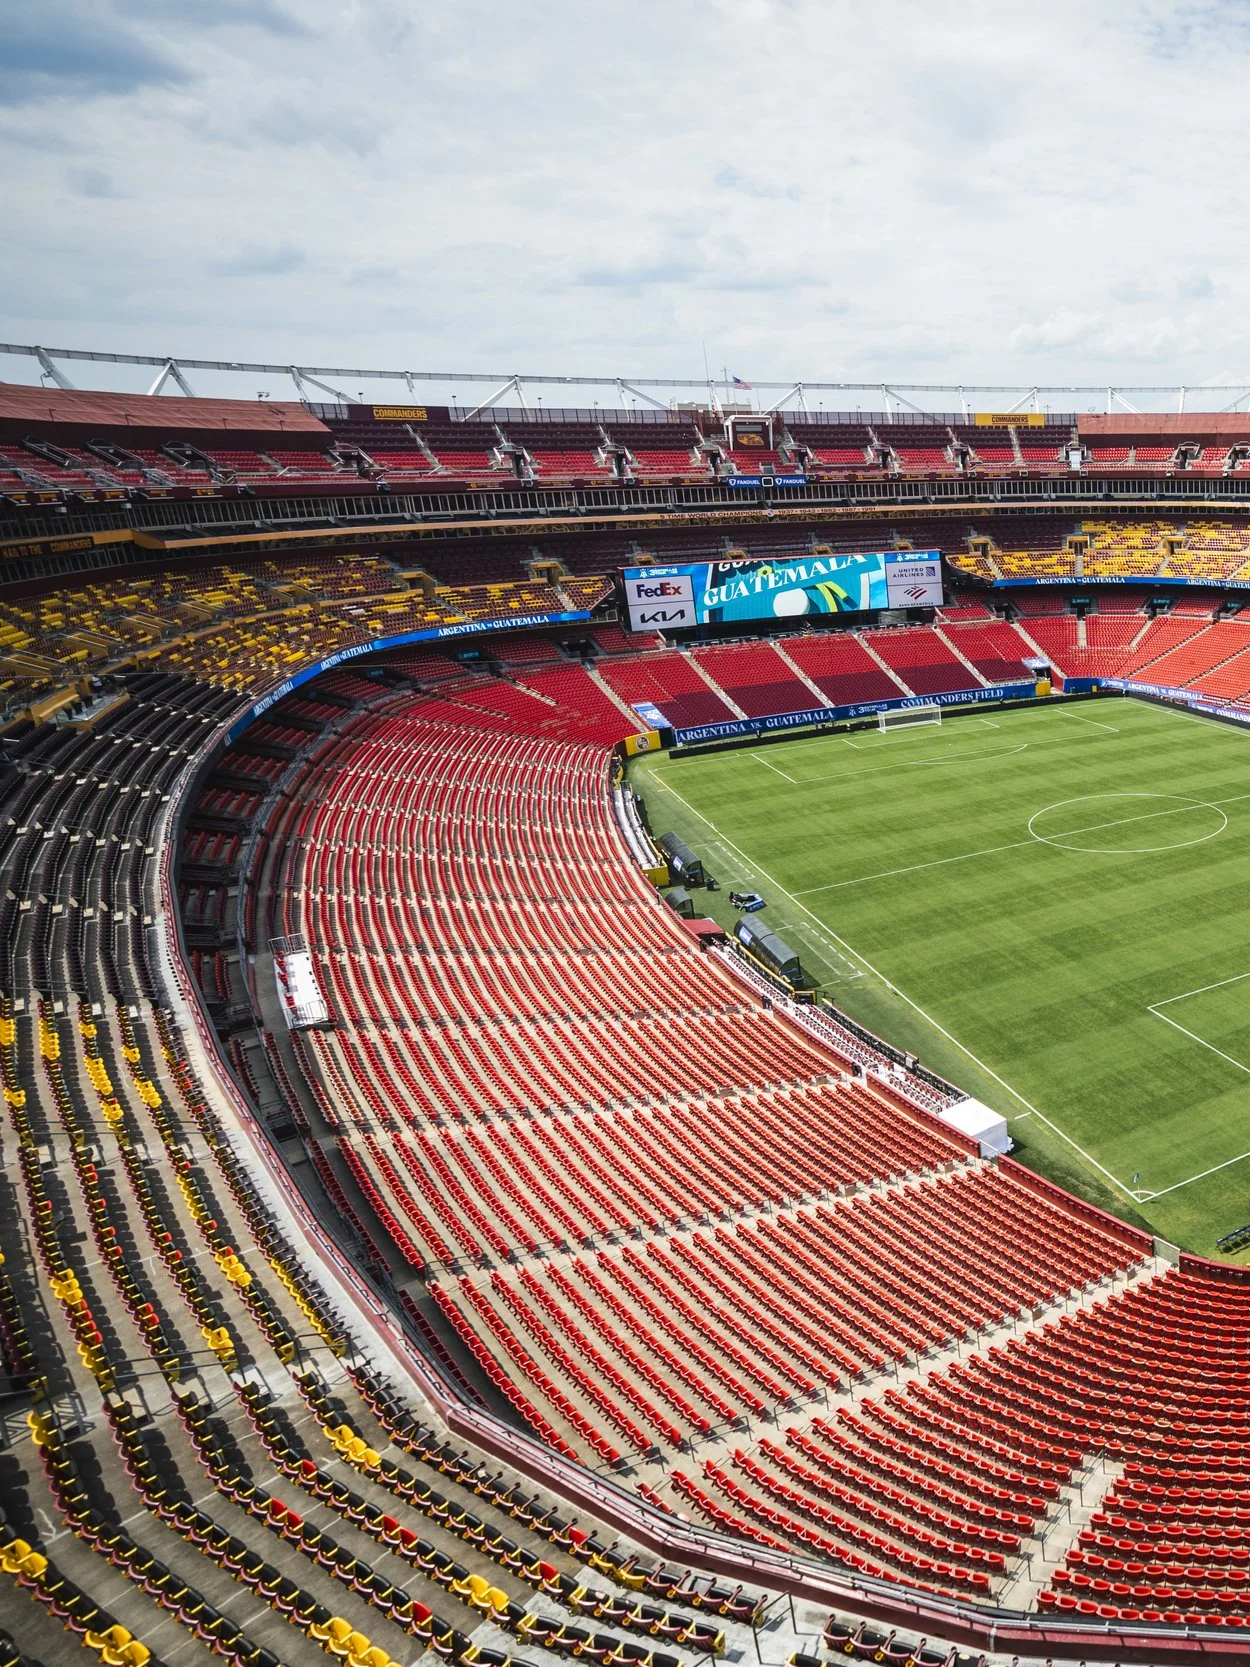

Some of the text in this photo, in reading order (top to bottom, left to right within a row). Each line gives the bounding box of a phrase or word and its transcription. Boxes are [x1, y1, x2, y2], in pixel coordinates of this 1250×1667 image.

[373, 409, 428, 419] COMMANDERS
[992, 416, 1028, 424] COMMANDERS
[50, 539, 92, 552] COMMANDERS
[702, 554, 868, 606] GUATEMALA
[1186, 579, 1221, 587] ARGENTINA
[636, 582, 682, 598] FedEx
[640, 610, 685, 624] KIA
[438, 622, 486, 636] ARGENTINA
[493, 615, 550, 629] GUATEMALA
[1128, 683, 1159, 694] ARGENTINA
[900, 689, 1004, 710] COMMANDERS FIELD
[678, 722, 745, 740] ARGENTINA
[766, 711, 834, 728] GUATEMALA
